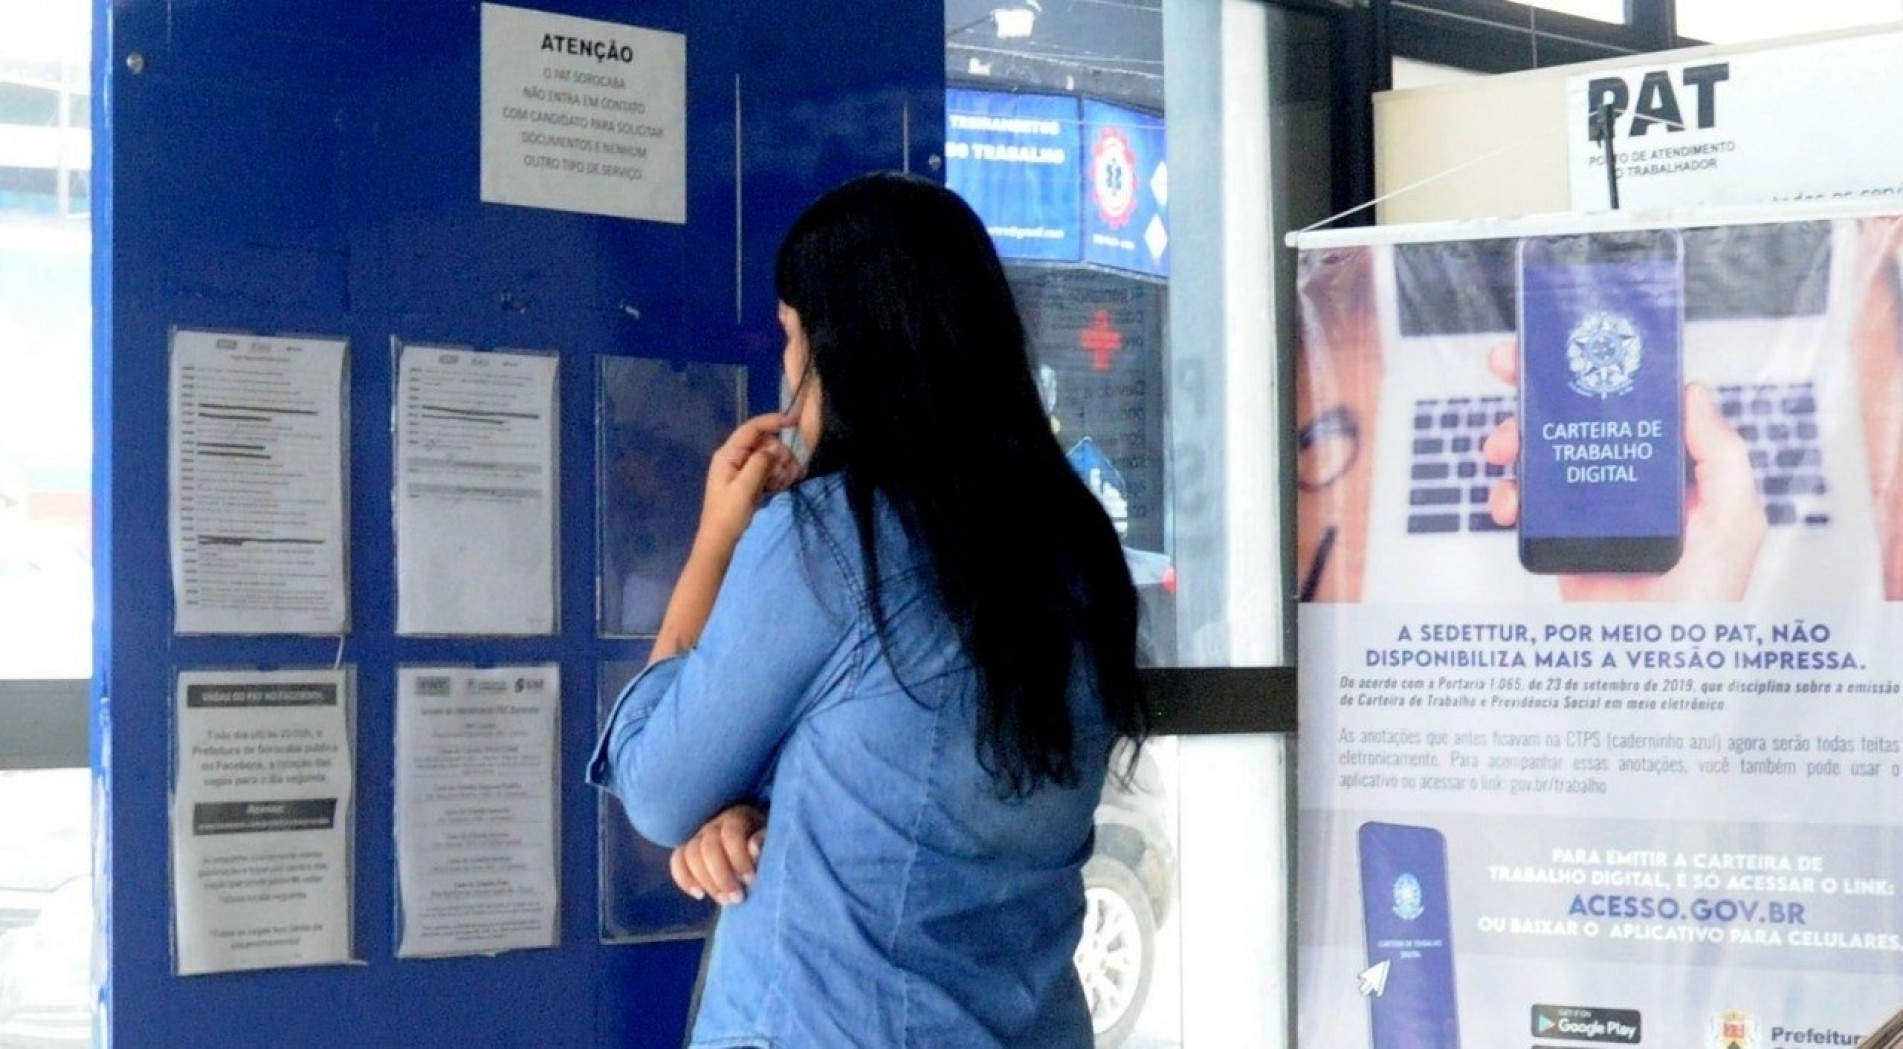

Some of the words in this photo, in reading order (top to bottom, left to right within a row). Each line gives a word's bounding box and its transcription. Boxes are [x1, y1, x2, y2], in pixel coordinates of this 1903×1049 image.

[541, 33, 633, 64] ATENÇÃO
[554, 68, 571, 81] PAT
[574, 70, 626, 90] SOROCABA
[524, 85, 546, 100] NÃO
[548, 88, 580, 105] ENTRA
[583, 93, 599, 107] EM
[601, 96, 646, 115] CONTATO
[1588, 62, 1730, 142] PAT
[502, 106, 528, 120] COM
[530, 109, 588, 129] CANDIDATO
[591, 117, 614, 132] PARA
[616, 121, 664, 138] SOLICITAR
[522, 131, 592, 152] DOCUMENTOS
[603, 141, 648, 159] NENHUM
[972, 144, 1065, 165] TRABALHO
[1589, 152, 1629, 168] POTO
[1632, 150, 1647, 162] DE
[1650, 140, 1736, 160] ATENDIMENTO
[524, 155, 560, 170] OUTRO
[562, 158, 584, 173] TIPO
[587, 162, 599, 174] DE
[1628, 158, 1718, 176] TRABALHADOR
[1542, 420, 1632, 441] CARTEIRA
[1637, 420, 1663, 438] DE
[1552, 442, 1653, 462] TRABALHO
[1566, 465, 1639, 484] DIGITAL
[1397, 625, 1412, 642] A
[1420, 624, 1537, 646] SEDETTUR,
[1545, 625, 1592, 642] POR
[1601, 624, 1662, 642] MEIO
[1670, 624, 1706, 643] DO
[1715, 624, 1762, 646] PAT,
[1772, 619, 1831, 643] NÃO
[1366, 650, 1526, 668] DISPONIBILIZA
[1534, 650, 1594, 668] MAIS
[1601, 651, 1617, 668] A
[1626, 646, 1726, 670] VERSÃO
[1734, 651, 1867, 670] IMPRESSA.
[1340, 676, 1354, 689] De
[1358, 677, 1398, 690] acordo
[1401, 680, 1424, 690] com
[1428, 680, 1435, 690] a
[1438, 678, 1485, 690] Portaria
[1528, 678, 1542, 690] de
[1546, 678, 1561, 690] 23
[1564, 679, 1578, 691] de
[1582, 679, 1640, 692] setembro
[1644, 679, 1658, 692] de
[1701, 682, 1723, 695] que
[1728, 680, 1791, 695] disciplina
[1796, 681, 1831, 694] sobre
[1835, 684, 1843, 694] a
[1848, 682, 1901, 695] emissão
[1340, 694, 1354, 706] de
[1358, 694, 1406, 707] Carteira
[1409, 694, 1423, 707] de
[1428, 695, 1476, 708] Trabalho
[1480, 698, 1487, 708] e
[1490, 694, 1559, 708] Previdência
[1564, 696, 1601, 709] Social
[1604, 700, 1622, 710] em
[1626, 698, 1656, 710] meio
[1339, 729, 1355, 743] As
[1360, 730, 1421, 746] anotações
[1426, 734, 1448, 748] que
[1454, 732, 1488, 746] antes
[1492, 731, 1540, 747] ficavam
[1545, 735, 1561, 747] na
[1566, 732, 1601, 748] CTPS
[1607, 734, 1684, 752] (caderninho
[1690, 734, 1722, 752] azul)
[1728, 736, 1767, 755] agora
[1772, 736, 1810, 752] serão
[1817, 736, 1855, 752] todas
[1861, 736, 1901, 753] feitas
[1450, 752, 1479, 768] Para
[1487, 754, 1563, 772] acompanhar
[1573, 757, 1609, 772] essas
[1618, 757, 1688, 776] anotações,
[1699, 758, 1730, 774] você
[1740, 758, 1796, 774] também
[1806, 760, 1840, 778] pode
[1851, 762, 1881, 777] usar
[1892, 764, 1900, 777] o
[1339, 773, 1399, 790] aplicativo
[1401, 777, 1415, 790] ou
[1419, 777, 1466, 790] acessar
[1470, 777, 1478, 790] o
[1510, 776, 1608, 796] gov.br/trabalho
[1552, 846, 1600, 867] PARA
[1606, 850, 1667, 868] EMITIR
[1673, 852, 1687, 868] A
[1693, 852, 1790, 871] CARTEIRA
[1797, 855, 1824, 873] DE
[1488, 866, 1587, 886] TRABALHO
[1591, 869, 1672, 890] DIGITAL,
[1676, 870, 1689, 888] É
[1692, 869, 1720, 890] SÓ
[1727, 874, 1815, 892] ACESSAR
[1822, 876, 1838, 893] O
[1843, 877, 1895, 897] LINK:
[1568, 894, 1806, 925] ACESSO.GOV.BR
[1478, 918, 1507, 934] OU
[1510, 918, 1583, 938] BAIXAR
[1585, 921, 1600, 938] O
[1609, 922, 1724, 944] APLICATIVO
[1730, 926, 1782, 946] PARA
[1787, 928, 1902, 951] CELULARES.
[1558, 1018, 1604, 1038] Google
[1606, 1020, 1637, 1041] Play
[1771, 1026, 1863, 1047] Prefeitur
